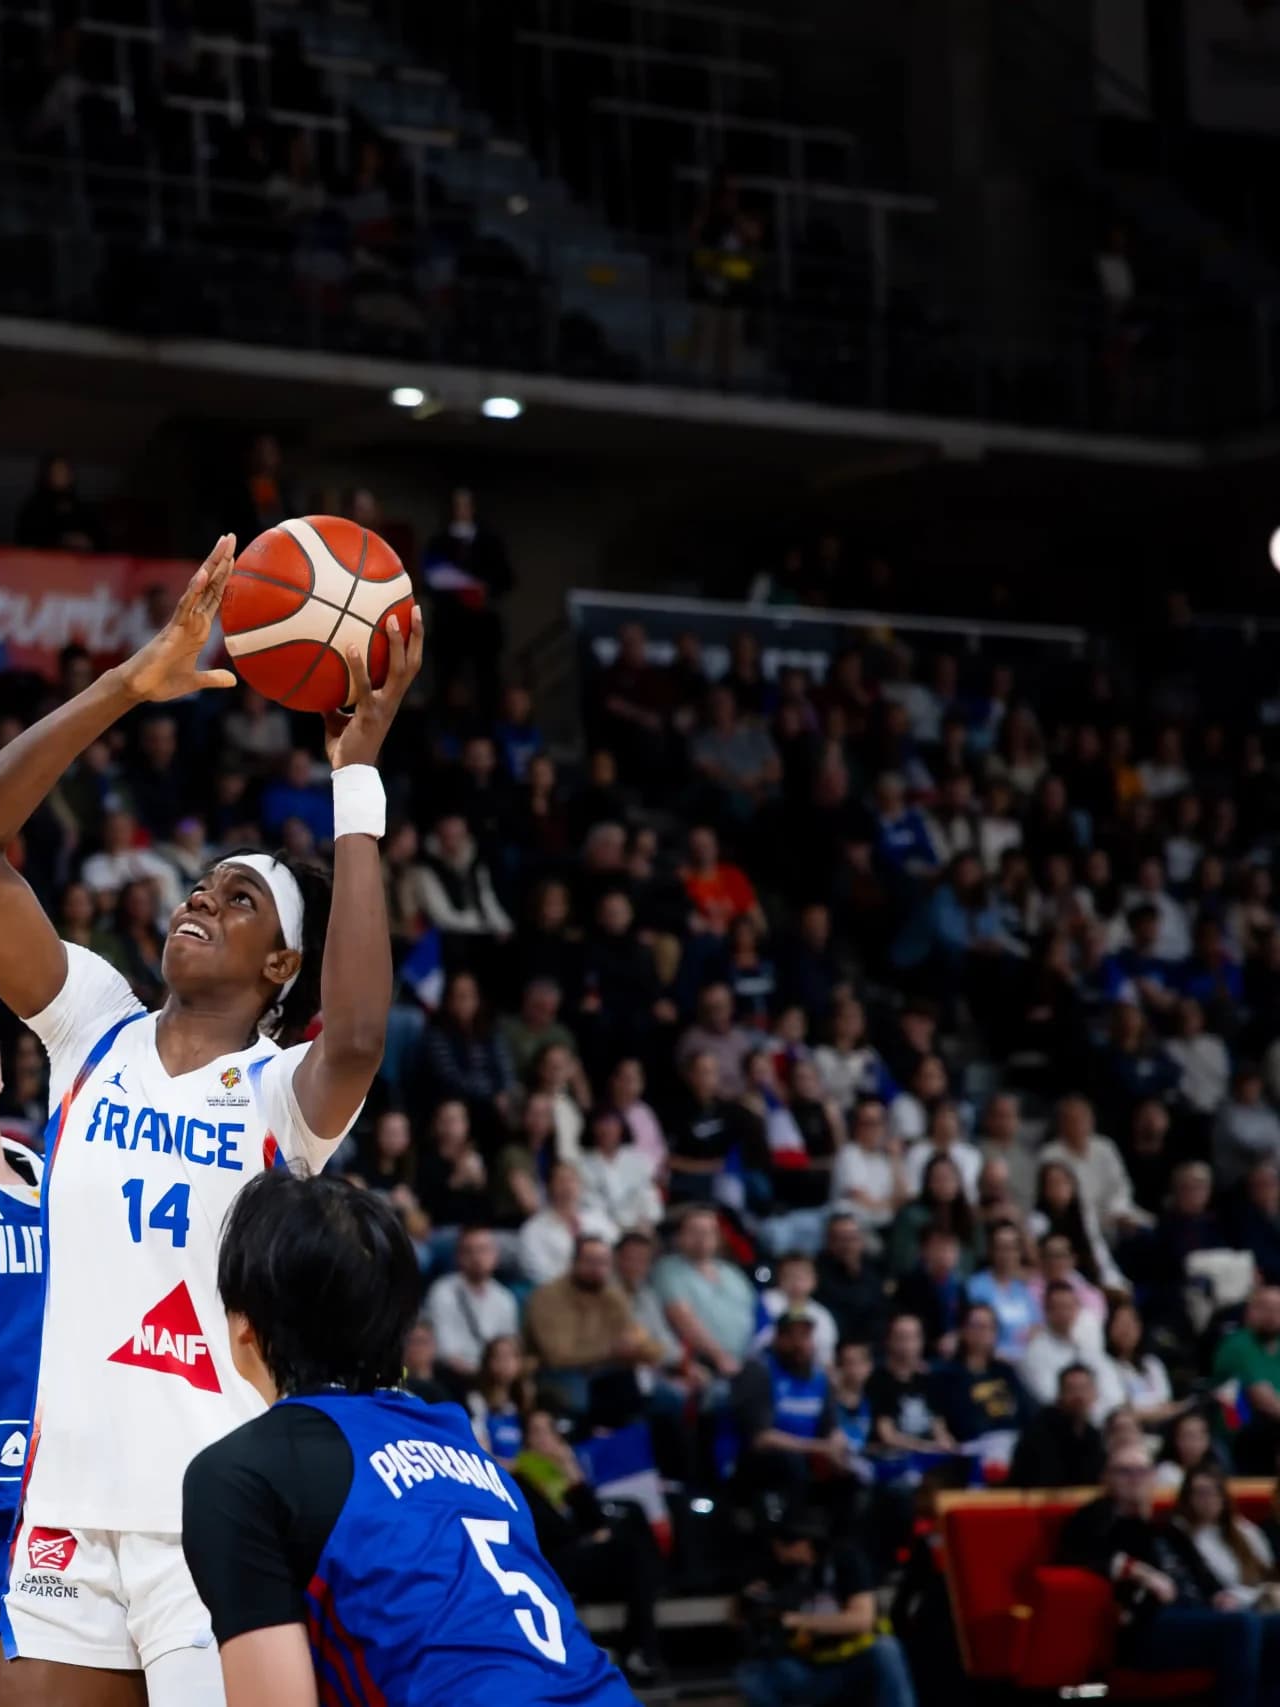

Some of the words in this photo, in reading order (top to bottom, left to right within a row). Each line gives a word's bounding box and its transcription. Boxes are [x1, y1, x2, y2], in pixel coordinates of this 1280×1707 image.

[85, 1097, 245, 1171] FRANCE
[121, 1178, 190, 1248] 14
[132, 1325, 207, 1366] MAIF
[369, 1440, 518, 1512] PASTRANA
[24, 1573, 65, 1586] CAISSE
[461, 1517, 566, 1664] 5
